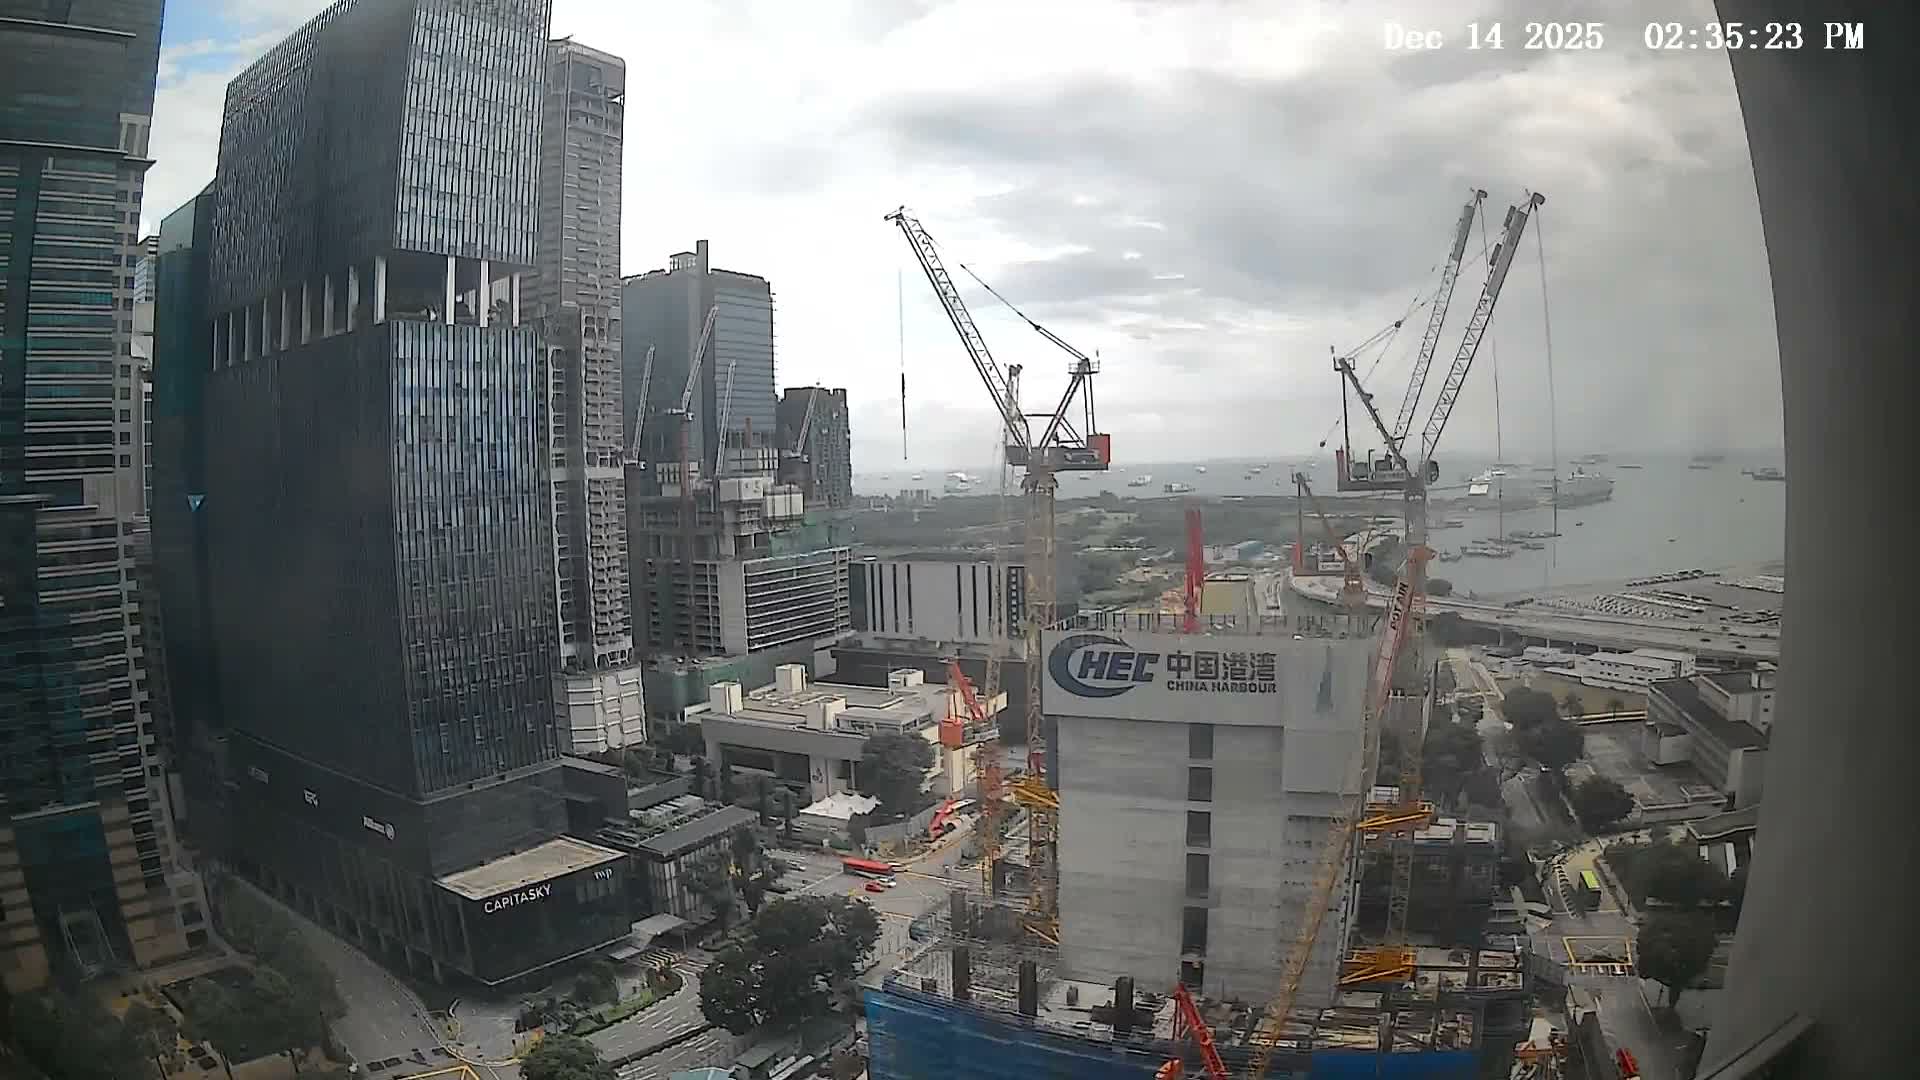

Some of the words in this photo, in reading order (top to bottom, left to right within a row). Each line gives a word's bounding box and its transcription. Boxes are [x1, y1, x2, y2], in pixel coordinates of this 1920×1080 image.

[1166, 650, 1277, 682] 中国港湾
[1167, 681, 1207, 693] CHINA
[1211, 682, 1277, 694] HARBOUR
[484, 884, 551, 912] CAPITASKY
